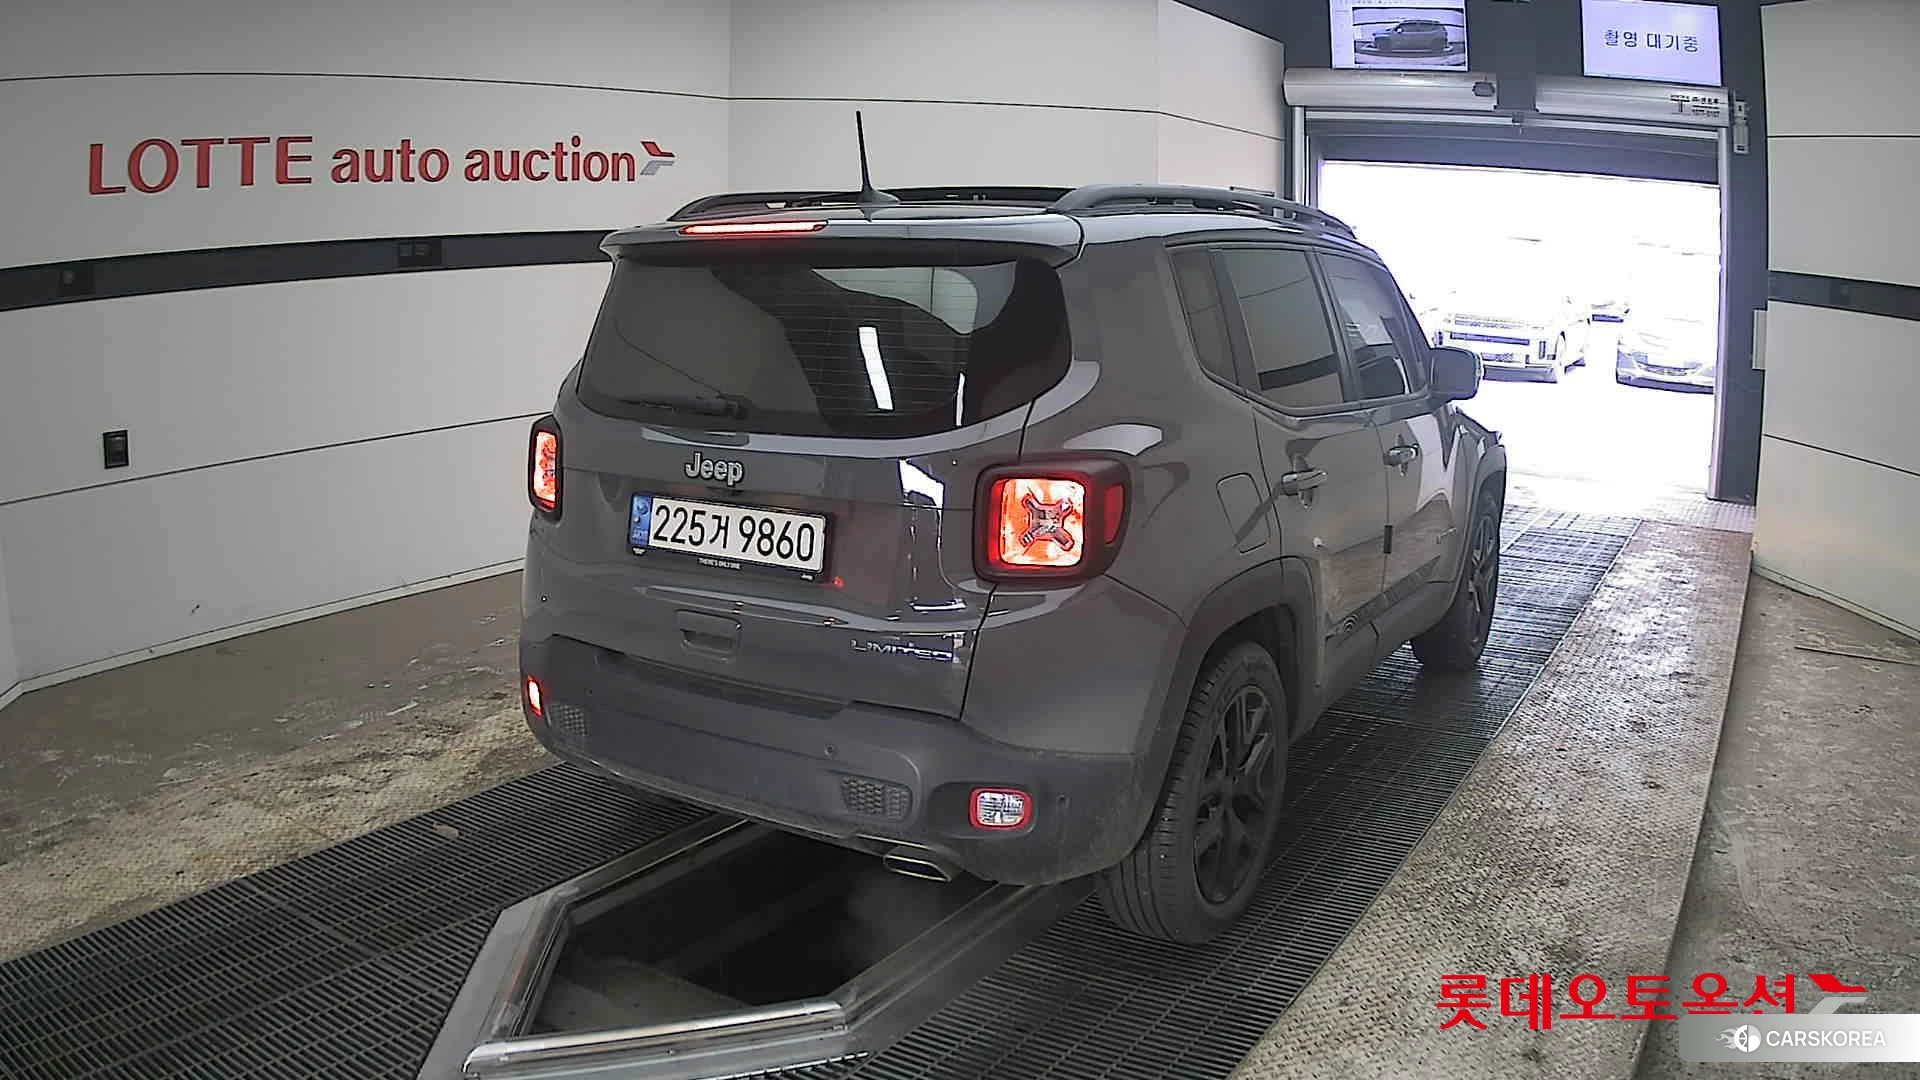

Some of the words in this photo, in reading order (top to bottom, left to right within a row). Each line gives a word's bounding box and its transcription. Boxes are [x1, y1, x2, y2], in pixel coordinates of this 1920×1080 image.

[1605, 29, 1637, 48] 촬영
[1646, 33, 1698, 53] 대기중
[88, 135, 313, 195] LOTTE
[331, 138, 450, 184] auto
[463, 135, 636, 183] auction
[684, 451, 744, 486] Jeep
[652, 504, 730, 549] 225거
[738, 515, 815, 563] 9860
[851, 638, 954, 662] LIMITED
